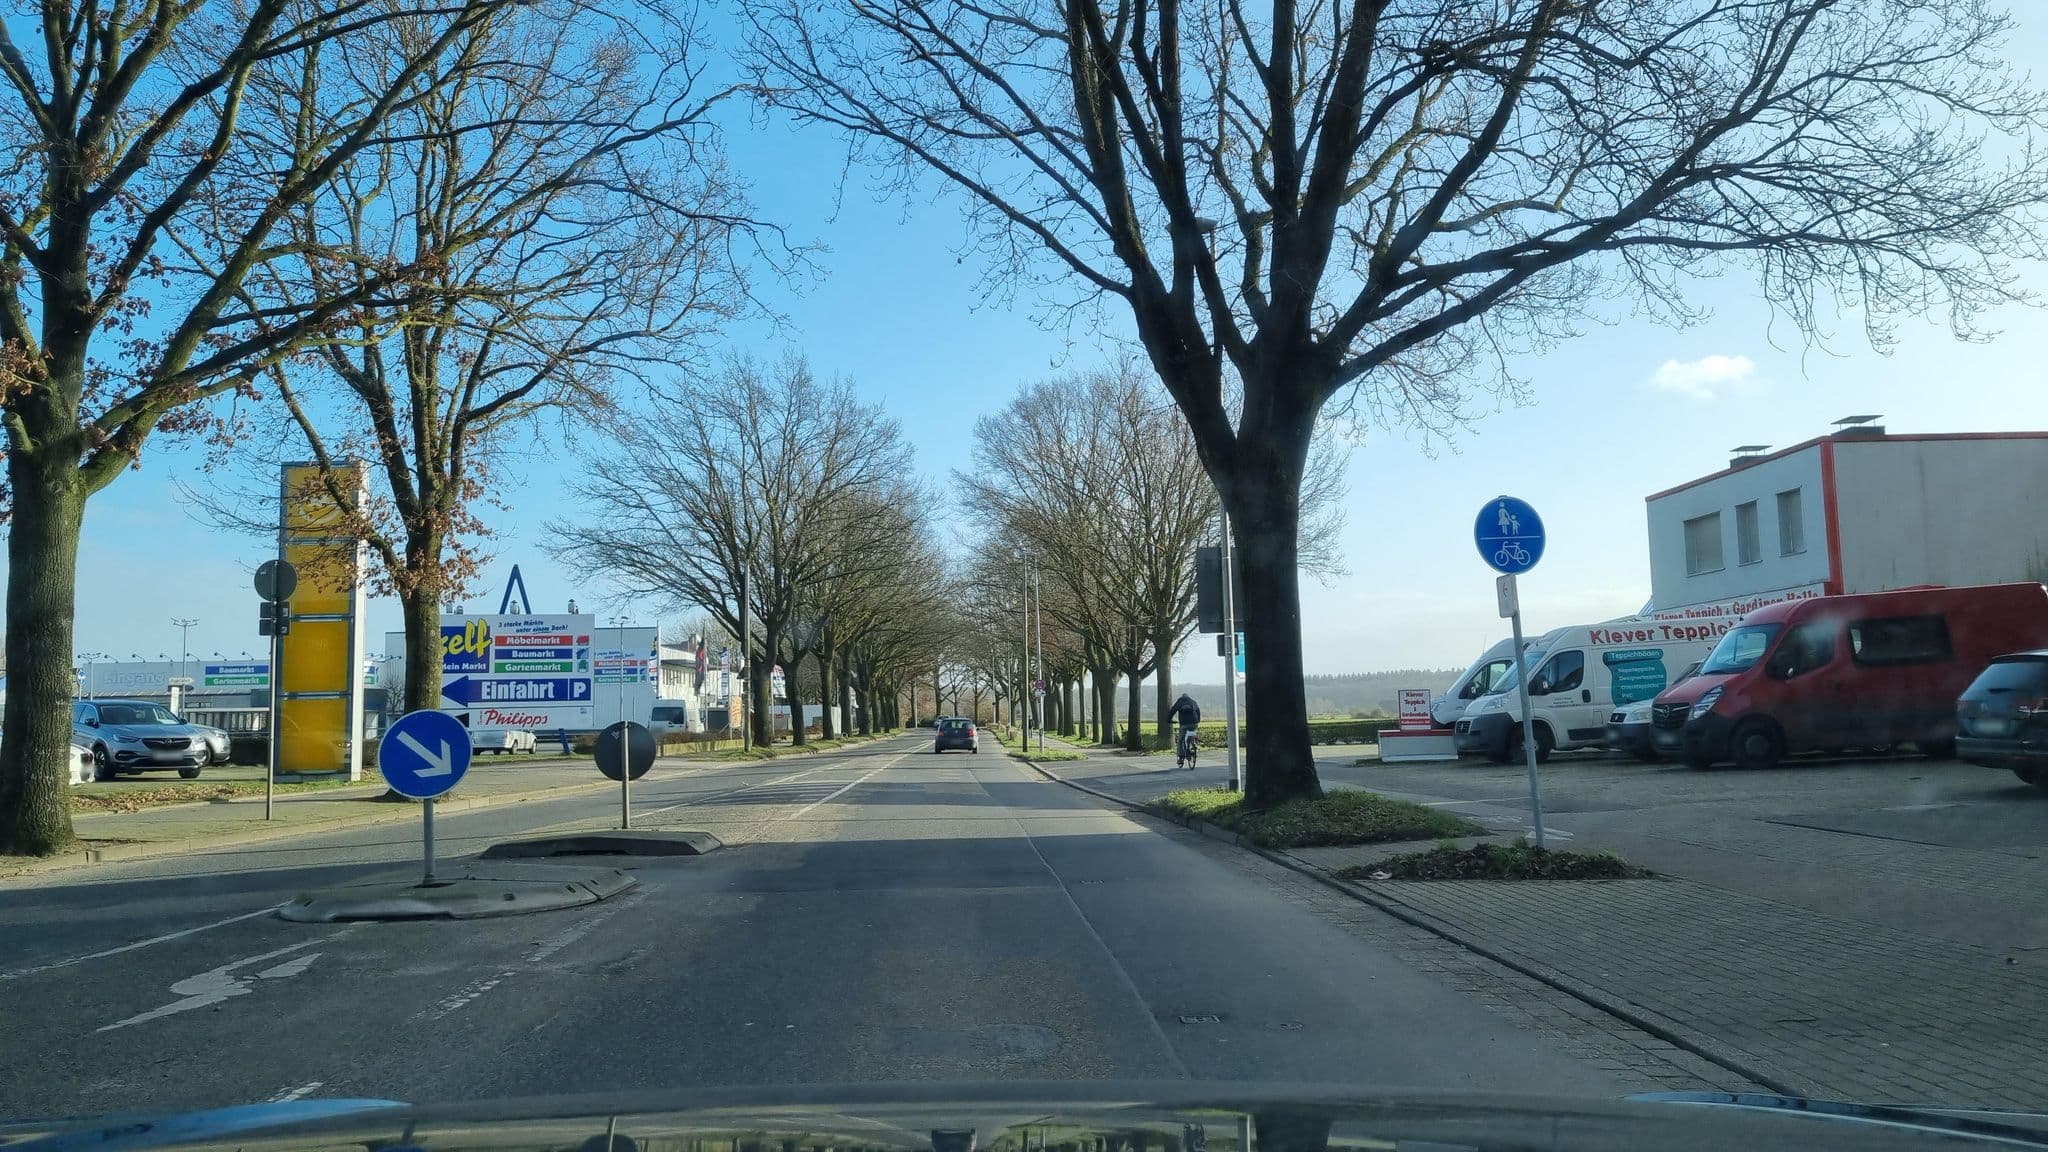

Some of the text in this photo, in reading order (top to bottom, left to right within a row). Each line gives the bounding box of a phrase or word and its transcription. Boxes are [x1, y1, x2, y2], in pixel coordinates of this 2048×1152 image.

[506, 635, 561, 645] Möbelmarkt
[1589, 628, 1655, 645] Klever
[512, 650, 555, 658] Baumarkt
[1610, 650, 1661, 659] Teppichböden
[219, 666, 255, 674] Baumarkt
[462, 662, 486, 670] Markt
[504, 663, 561, 672] Gartenmarkt
[481, 681, 587, 700] Einfahrt P
[483, 708, 549, 728] Philipps
